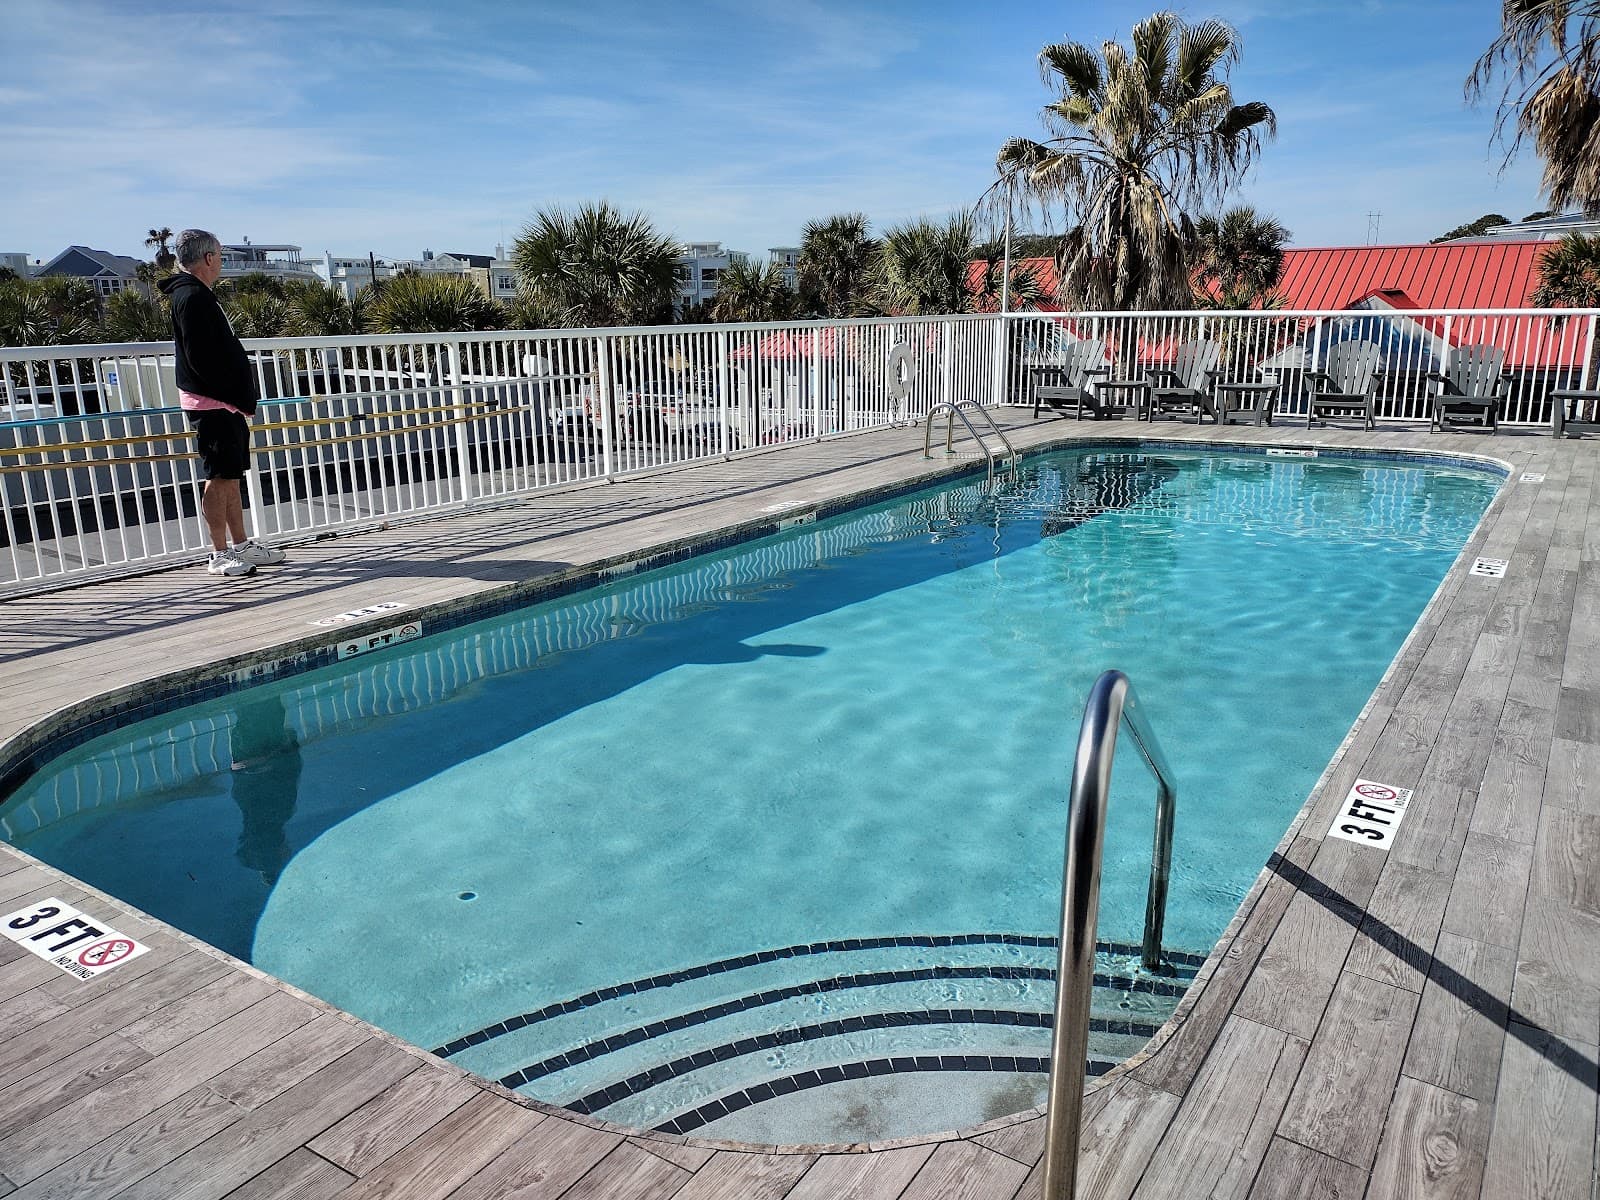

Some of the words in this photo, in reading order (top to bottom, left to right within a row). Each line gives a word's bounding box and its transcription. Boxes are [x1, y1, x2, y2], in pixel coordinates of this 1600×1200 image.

[346, 644, 359, 655] 3
[368, 633, 393, 648] FT
[1348, 799, 1395, 825] FT
[1340, 824, 1384, 840] 3
[8, 907, 60, 929] 3
[30, 918, 104, 952] FT
[56, 955, 69, 966] NO
[65, 960, 95, 979] DIVING
